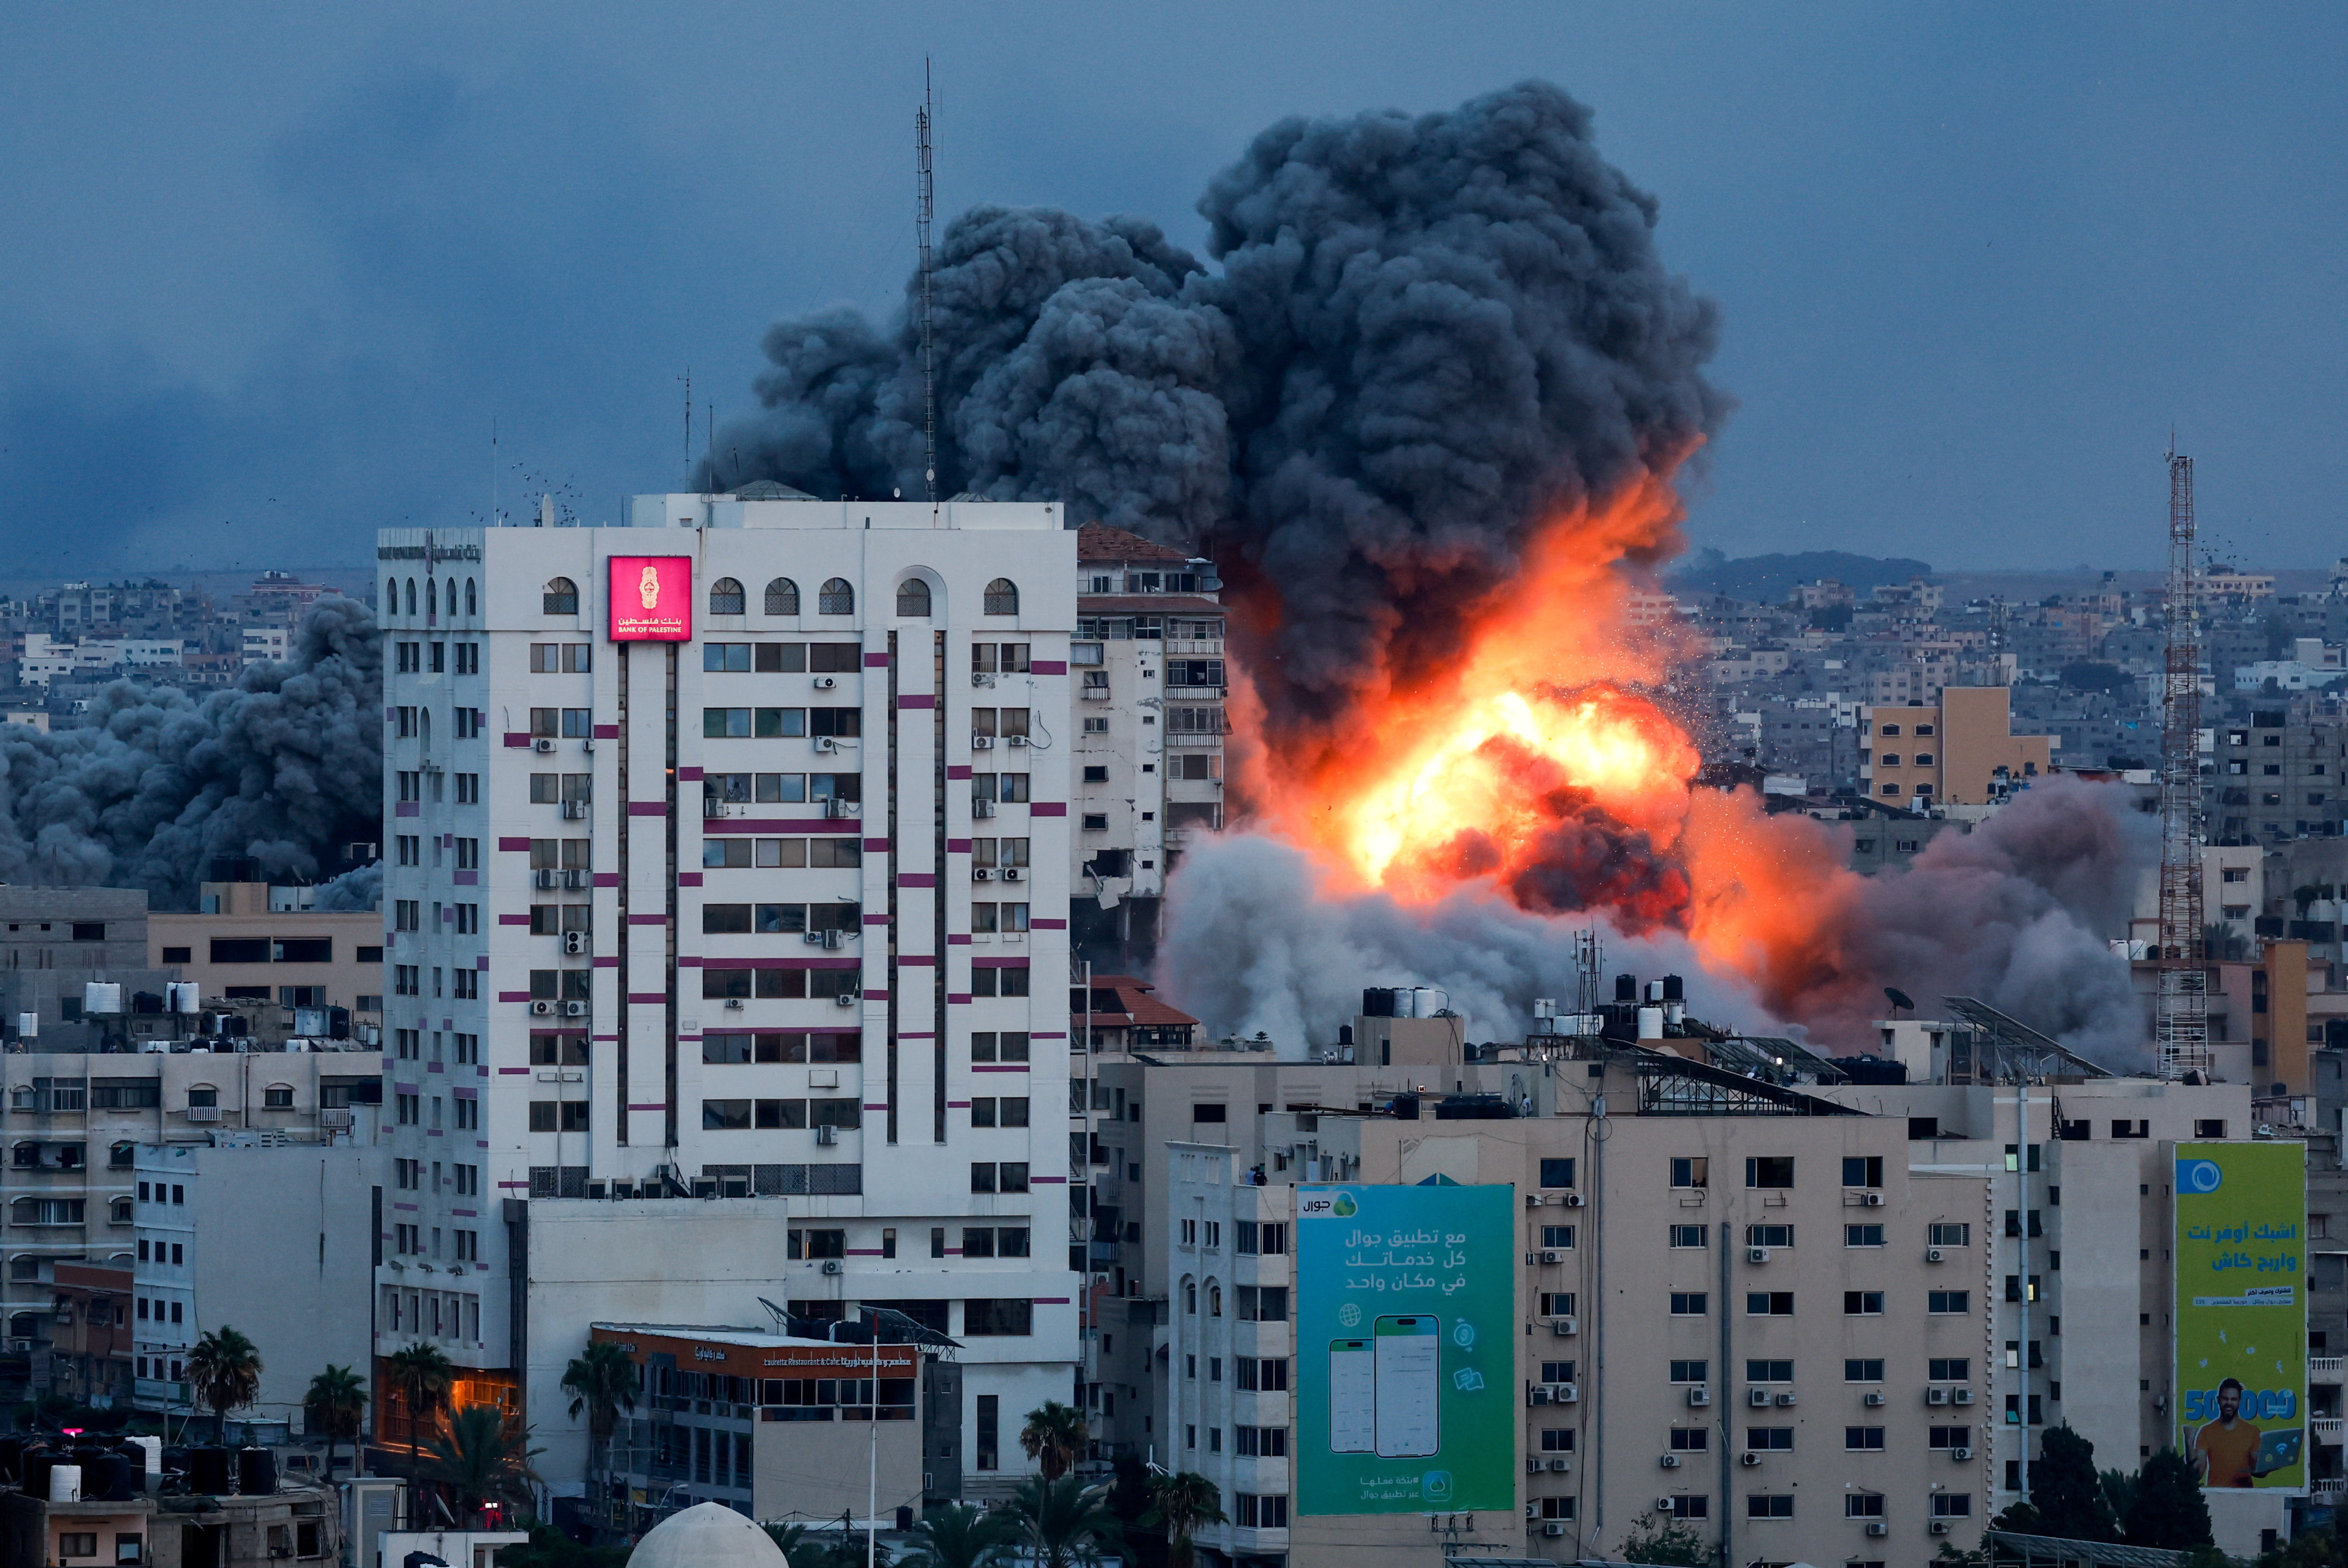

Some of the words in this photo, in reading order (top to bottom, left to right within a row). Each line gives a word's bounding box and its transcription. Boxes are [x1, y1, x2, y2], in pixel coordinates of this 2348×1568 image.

[618, 617, 659, 626] فلسطين
[660, 617, 682, 626] بنك
[1303, 1201, 1331, 1212] جوال
[1345, 1229, 1382, 1248] جوال
[1388, 1228, 1439, 1248] تطبيق
[1445, 1233, 1466, 1248] مع
[2187, 1226, 2211, 1239] نت
[2214, 1220, 2249, 1244] أوفر
[2253, 1222, 2296, 1243] اشبك
[1443, 1250, 1466, 1269] كل
[2212, 1251, 2252, 1271] كاش
[2257, 1252, 2296, 1272] واربح
[1345, 1273, 1385, 1291] واحد
[1391, 1272, 1435, 1291] مكان
[1441, 1273, 1466, 1296] في
[841, 1357, 860, 1367] لوريتا
[889, 1357, 912, 1367] مطعم
[1360, 1490, 1378, 1500] جوال
[1381, 1490, 1406, 1500] تطبيق
